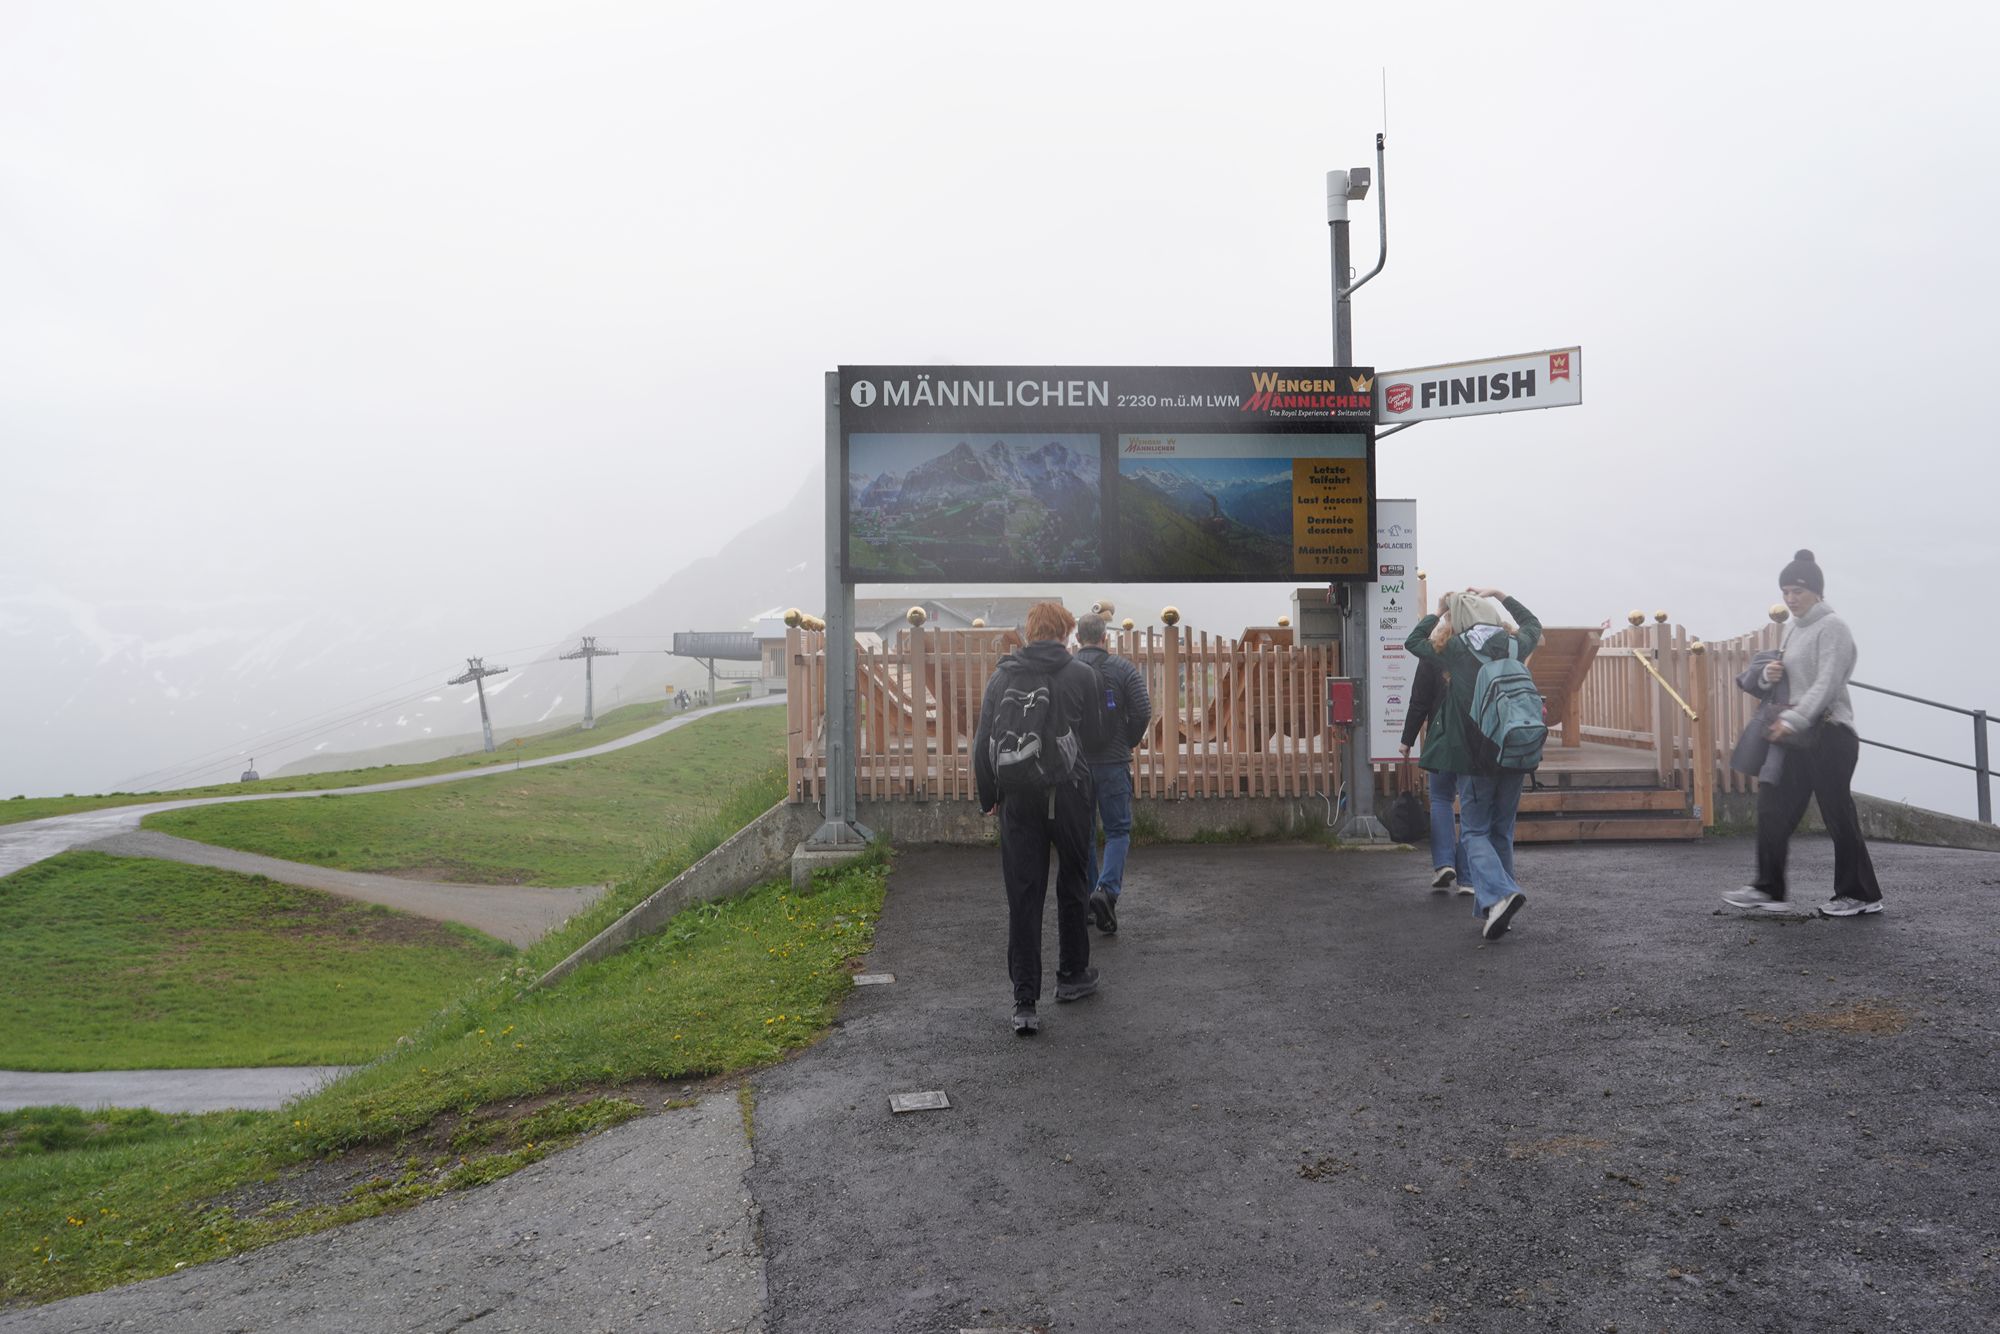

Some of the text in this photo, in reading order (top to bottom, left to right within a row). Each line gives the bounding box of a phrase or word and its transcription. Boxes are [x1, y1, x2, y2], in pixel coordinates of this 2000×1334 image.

[1251, 371, 1335, 393] WENGEN
[883, 374, 1109, 407] MÄNNLICHEN
[1206, 395, 1240, 407] LWM
[1421, 369, 1536, 409] FINISH
[1240, 392, 1371, 411] MÄNNLICHEN
[1313, 465, 1346, 474] Letzte
[1297, 495, 1363, 504] Last descent
[1307, 526, 1354, 534] descente
[1298, 545, 1363, 555] Männlichen:
[1314, 556, 1349, 565] 17:10
